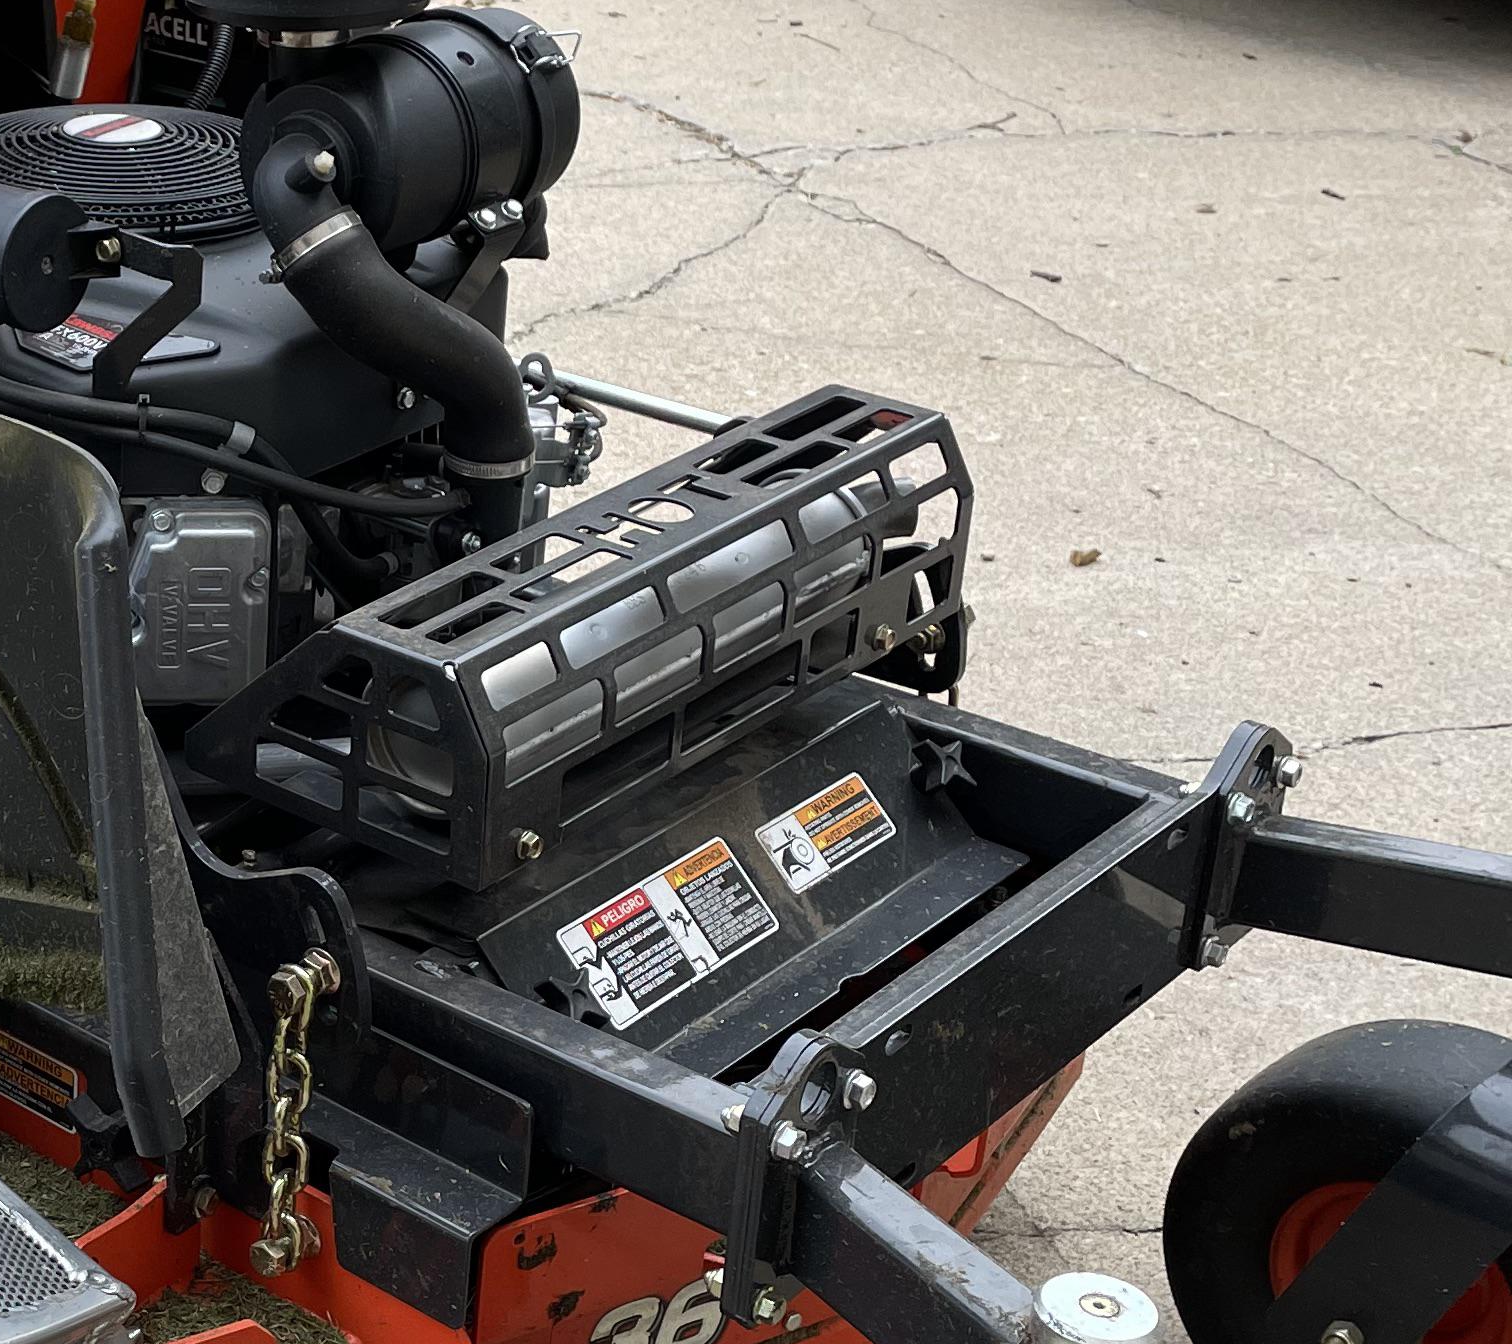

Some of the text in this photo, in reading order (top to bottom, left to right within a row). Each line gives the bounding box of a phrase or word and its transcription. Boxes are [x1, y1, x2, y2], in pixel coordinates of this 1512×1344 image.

[574, 473, 733, 549] HOT
[186, 567, 232, 668] OHV
[811, 783, 855, 814] WARNING
[600, 894, 645, 927] PELIGRO
[8, 1039, 63, 1077] WARNING
